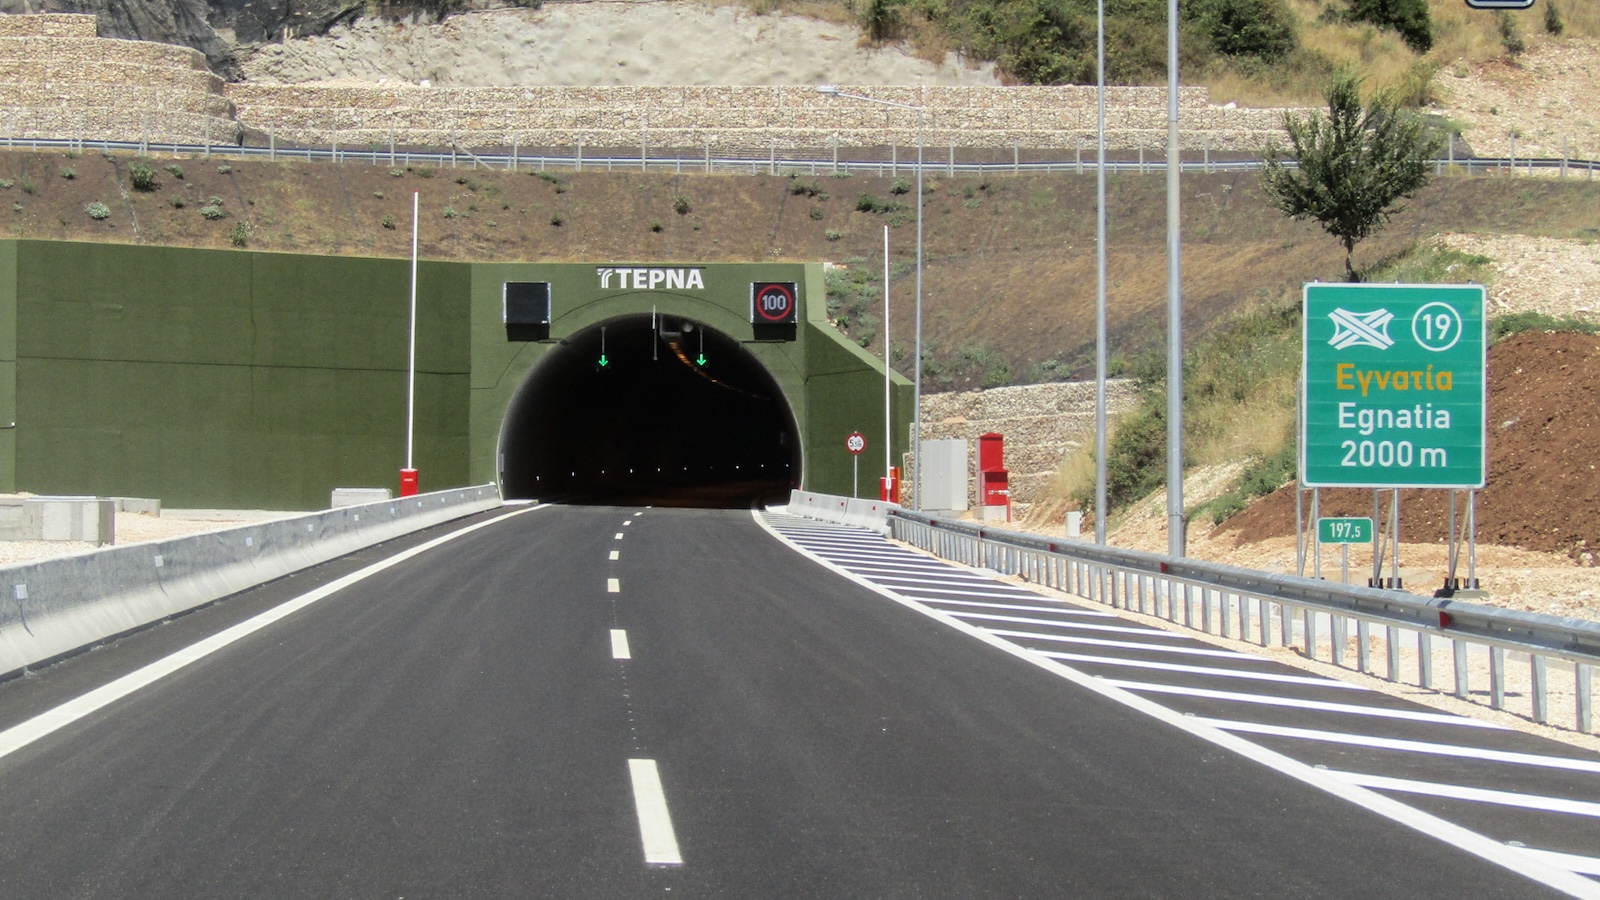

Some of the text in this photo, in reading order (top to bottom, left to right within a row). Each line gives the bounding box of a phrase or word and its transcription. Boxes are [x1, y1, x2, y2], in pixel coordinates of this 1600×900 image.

[762, 295, 787, 310] 100
[1422, 313, 1451, 340] 19
[1336, 363, 1452, 397] Εγνατία
[1339, 402, 1450, 435] Egnatia
[1341, 440, 1447, 467] 2000 m
